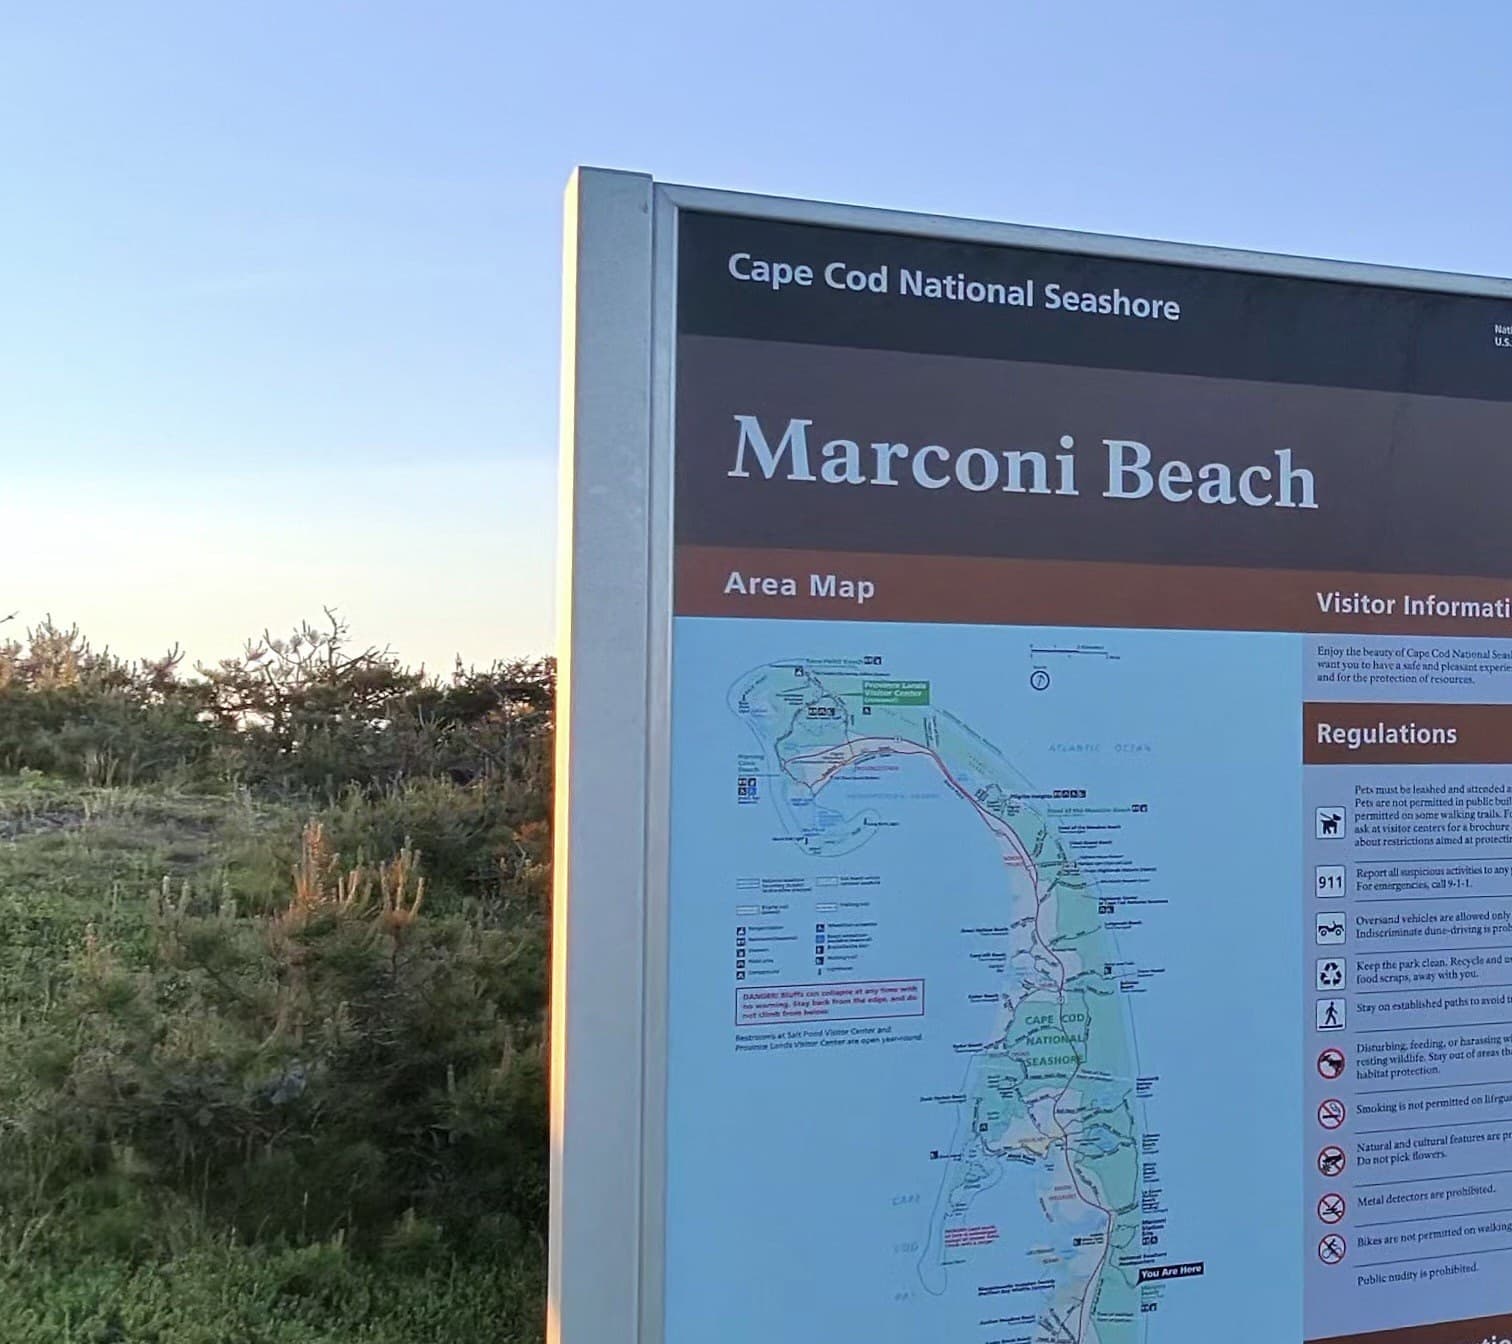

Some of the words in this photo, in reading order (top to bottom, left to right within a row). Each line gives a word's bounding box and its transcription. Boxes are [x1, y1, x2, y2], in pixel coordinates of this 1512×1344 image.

[728, 253, 812, 289] Cape
[824, 262, 887, 292] Cod
[900, 269, 1033, 306] National
[1045, 283, 1180, 320] Seashore
[1494, 338, 1511, 347] U.S.
[727, 414, 1078, 495] Marconi
[1102, 439, 1318, 508] Beach
[724, 572, 796, 595] Area
[810, 574, 874, 603] Map
[1317, 591, 1395, 614] Visitor
[1317, 672, 1334, 681] and
[1337, 672, 1350, 682] for
[1352, 672, 1367, 682] the
[1369, 674, 1417, 685] protection
[1419, 674, 1427, 682] of
[1317, 722, 1456, 748] Regulations
[1048, 744, 1100, 752] ATLANTIC
[1318, 876, 1342, 889] 911
[1356, 881, 1372, 891] For
[1373, 882, 1429, 892] emergencies,
[1431, 879, 1446, 888] call
[1356, 928, 1422, 938] Indiscriminate
[1424, 925, 1482, 935] dune-driving
[1356, 973, 1378, 984] food
[1379, 975, 1410, 984] scraps,
[1413, 973, 1435, 982] away
[1438, 969, 1457, 979] with
[1459, 970, 1478, 980] you.
[1356, 1003, 1375, 1014] Stay
[1392, 998, 1442, 1010] established
[1444, 997, 1468, 1009] paths
[1481, 994, 1505, 1004] avoid
[1025, 1015, 1054, 1024] CAPE
[1062, 1014, 1084, 1023] COD
[1026, 1035, 1084, 1045] NATIONAL
[1026, 1056, 1084, 1067] SEASHORE
[1356, 1069, 1388, 1079] habitat
[1390, 1066, 1440, 1079] protection.
[1356, 1103, 1396, 1114] Smoking
[1398, 1102, 1405, 1110] is
[1408, 1101, 1423, 1110] not
[1425, 1096, 1469, 1111] permitted
[1356, 1156, 1370, 1166] Do
[1372, 1155, 1388, 1164] not
[1390, 1152, 1410, 1165] pick
[1357, 1195, 1384, 1206] Metal
[1386, 1193, 1428, 1203] detectors
[1446, 1184, 1496, 1200] prohibited.
[1141, 1270, 1159, 1278] You
[1162, 1268, 1178, 1276] Are
[1180, 1266, 1201, 1274] Here
[1357, 1274, 1386, 1286] Public
[1388, 1271, 1417, 1281] nudity
[1420, 1270, 1427, 1278] is
[1429, 1263, 1478, 1280] prohibited.
